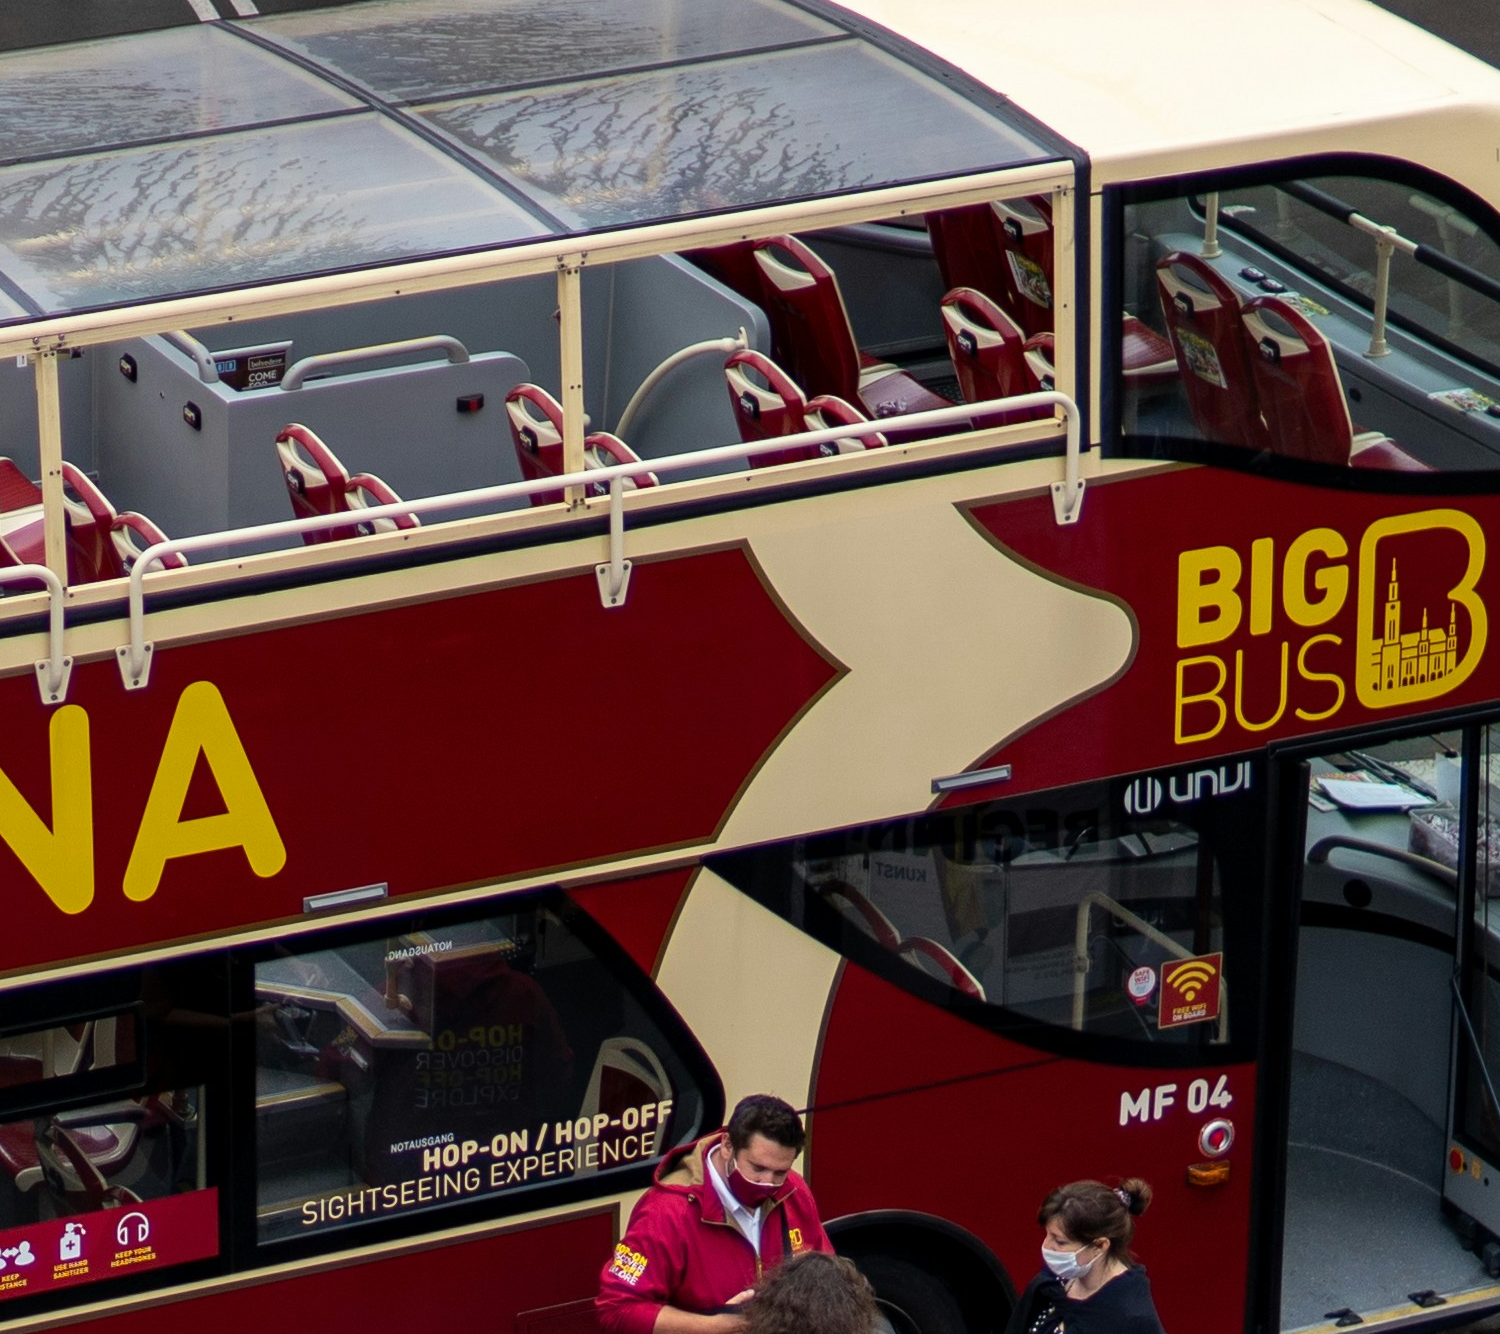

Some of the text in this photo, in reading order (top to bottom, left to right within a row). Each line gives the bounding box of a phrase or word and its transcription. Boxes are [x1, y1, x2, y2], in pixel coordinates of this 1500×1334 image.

[248, 369, 277, 383] COME
[1177, 527, 1350, 649] BIG
[1174, 632, 1346, 745] BUS
[1119, 1074, 1234, 1127] MF 04
[390, 1133, 455, 1154] NOTAUSGANG
[423, 1128, 528, 1172] HOP-ON
[555, 1100, 674, 1146] HOP-OFF
[301, 1131, 656, 1226] SIGHTSEEING EXPERIENCE
[110, 1253, 157, 1268] HEADPHONES
[114, 1249, 133, 1260] KEEP
[1, 1273, 20, 1283] KEEP
